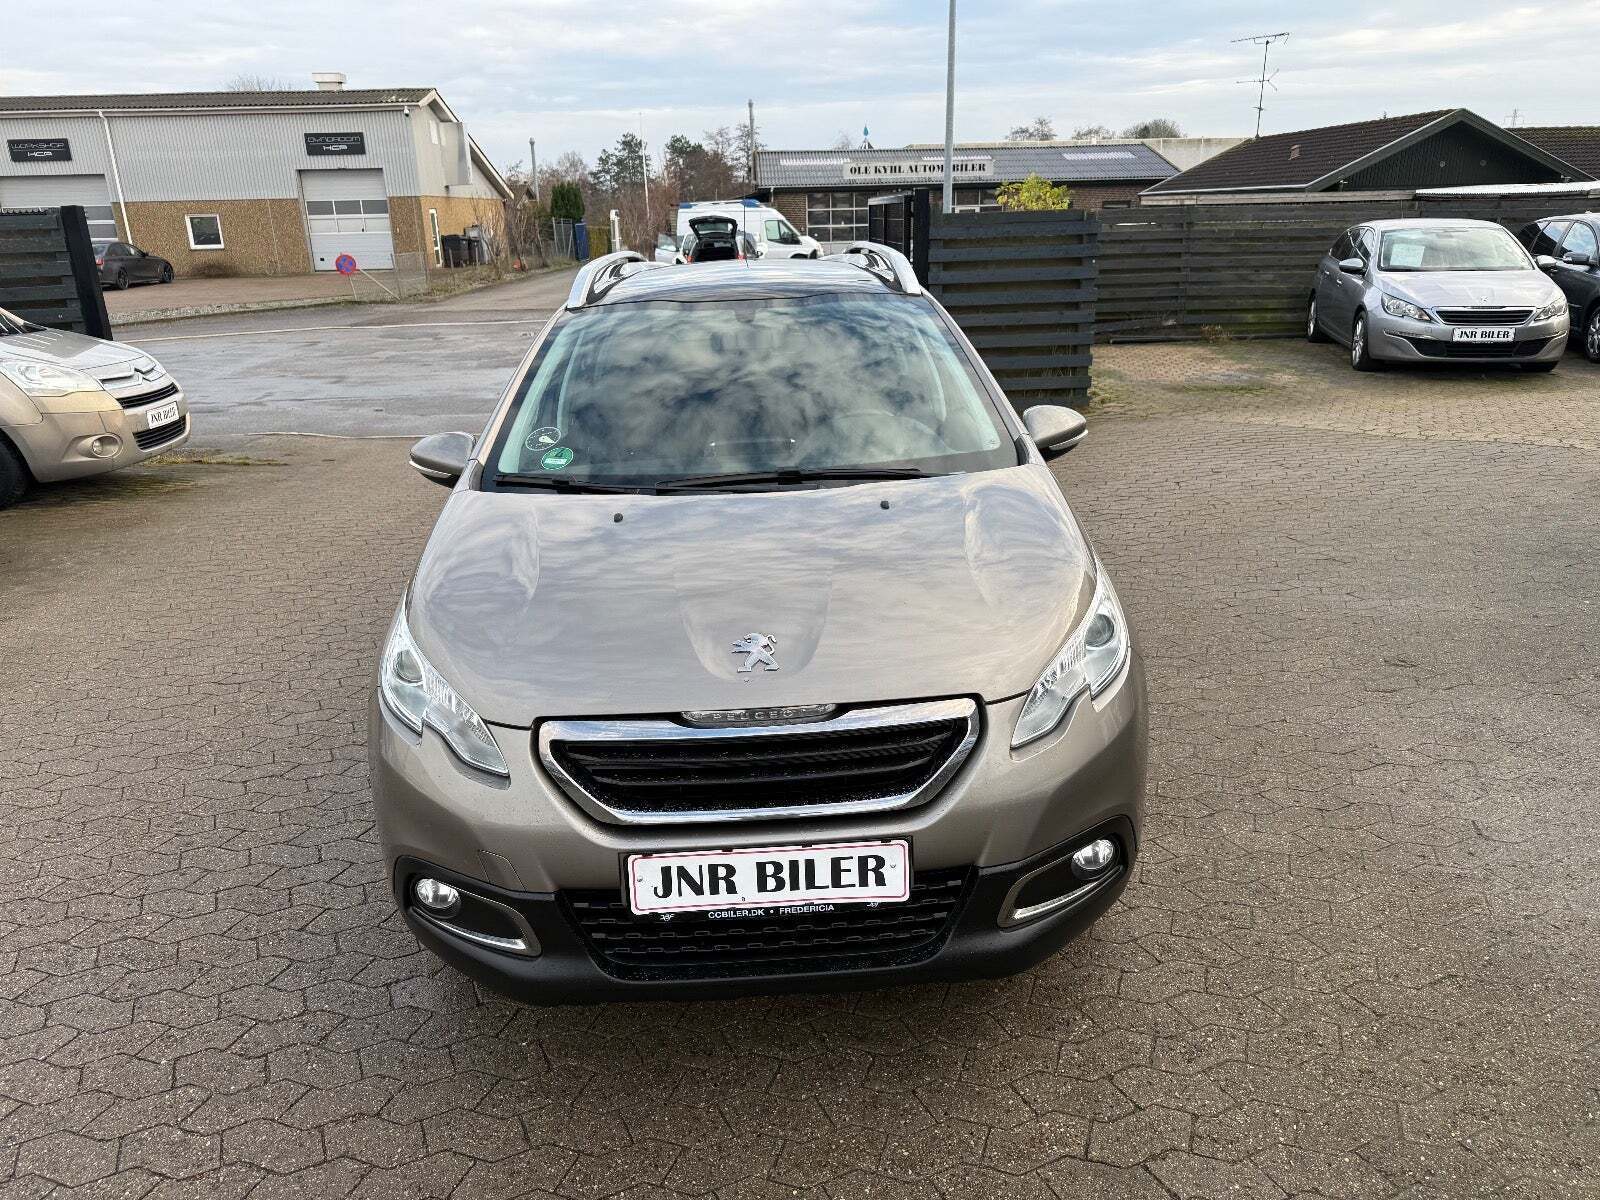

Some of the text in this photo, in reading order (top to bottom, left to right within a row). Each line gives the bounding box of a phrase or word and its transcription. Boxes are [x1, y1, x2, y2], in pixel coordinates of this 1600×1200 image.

[850, 162, 986, 175] OLE KYHL AUTOMBILER
[1458, 330, 1510, 339] JNR BILER
[653, 854, 887, 899] JNR BILER
[708, 904, 835, 919] CCBILER.DK FREDERICIA
